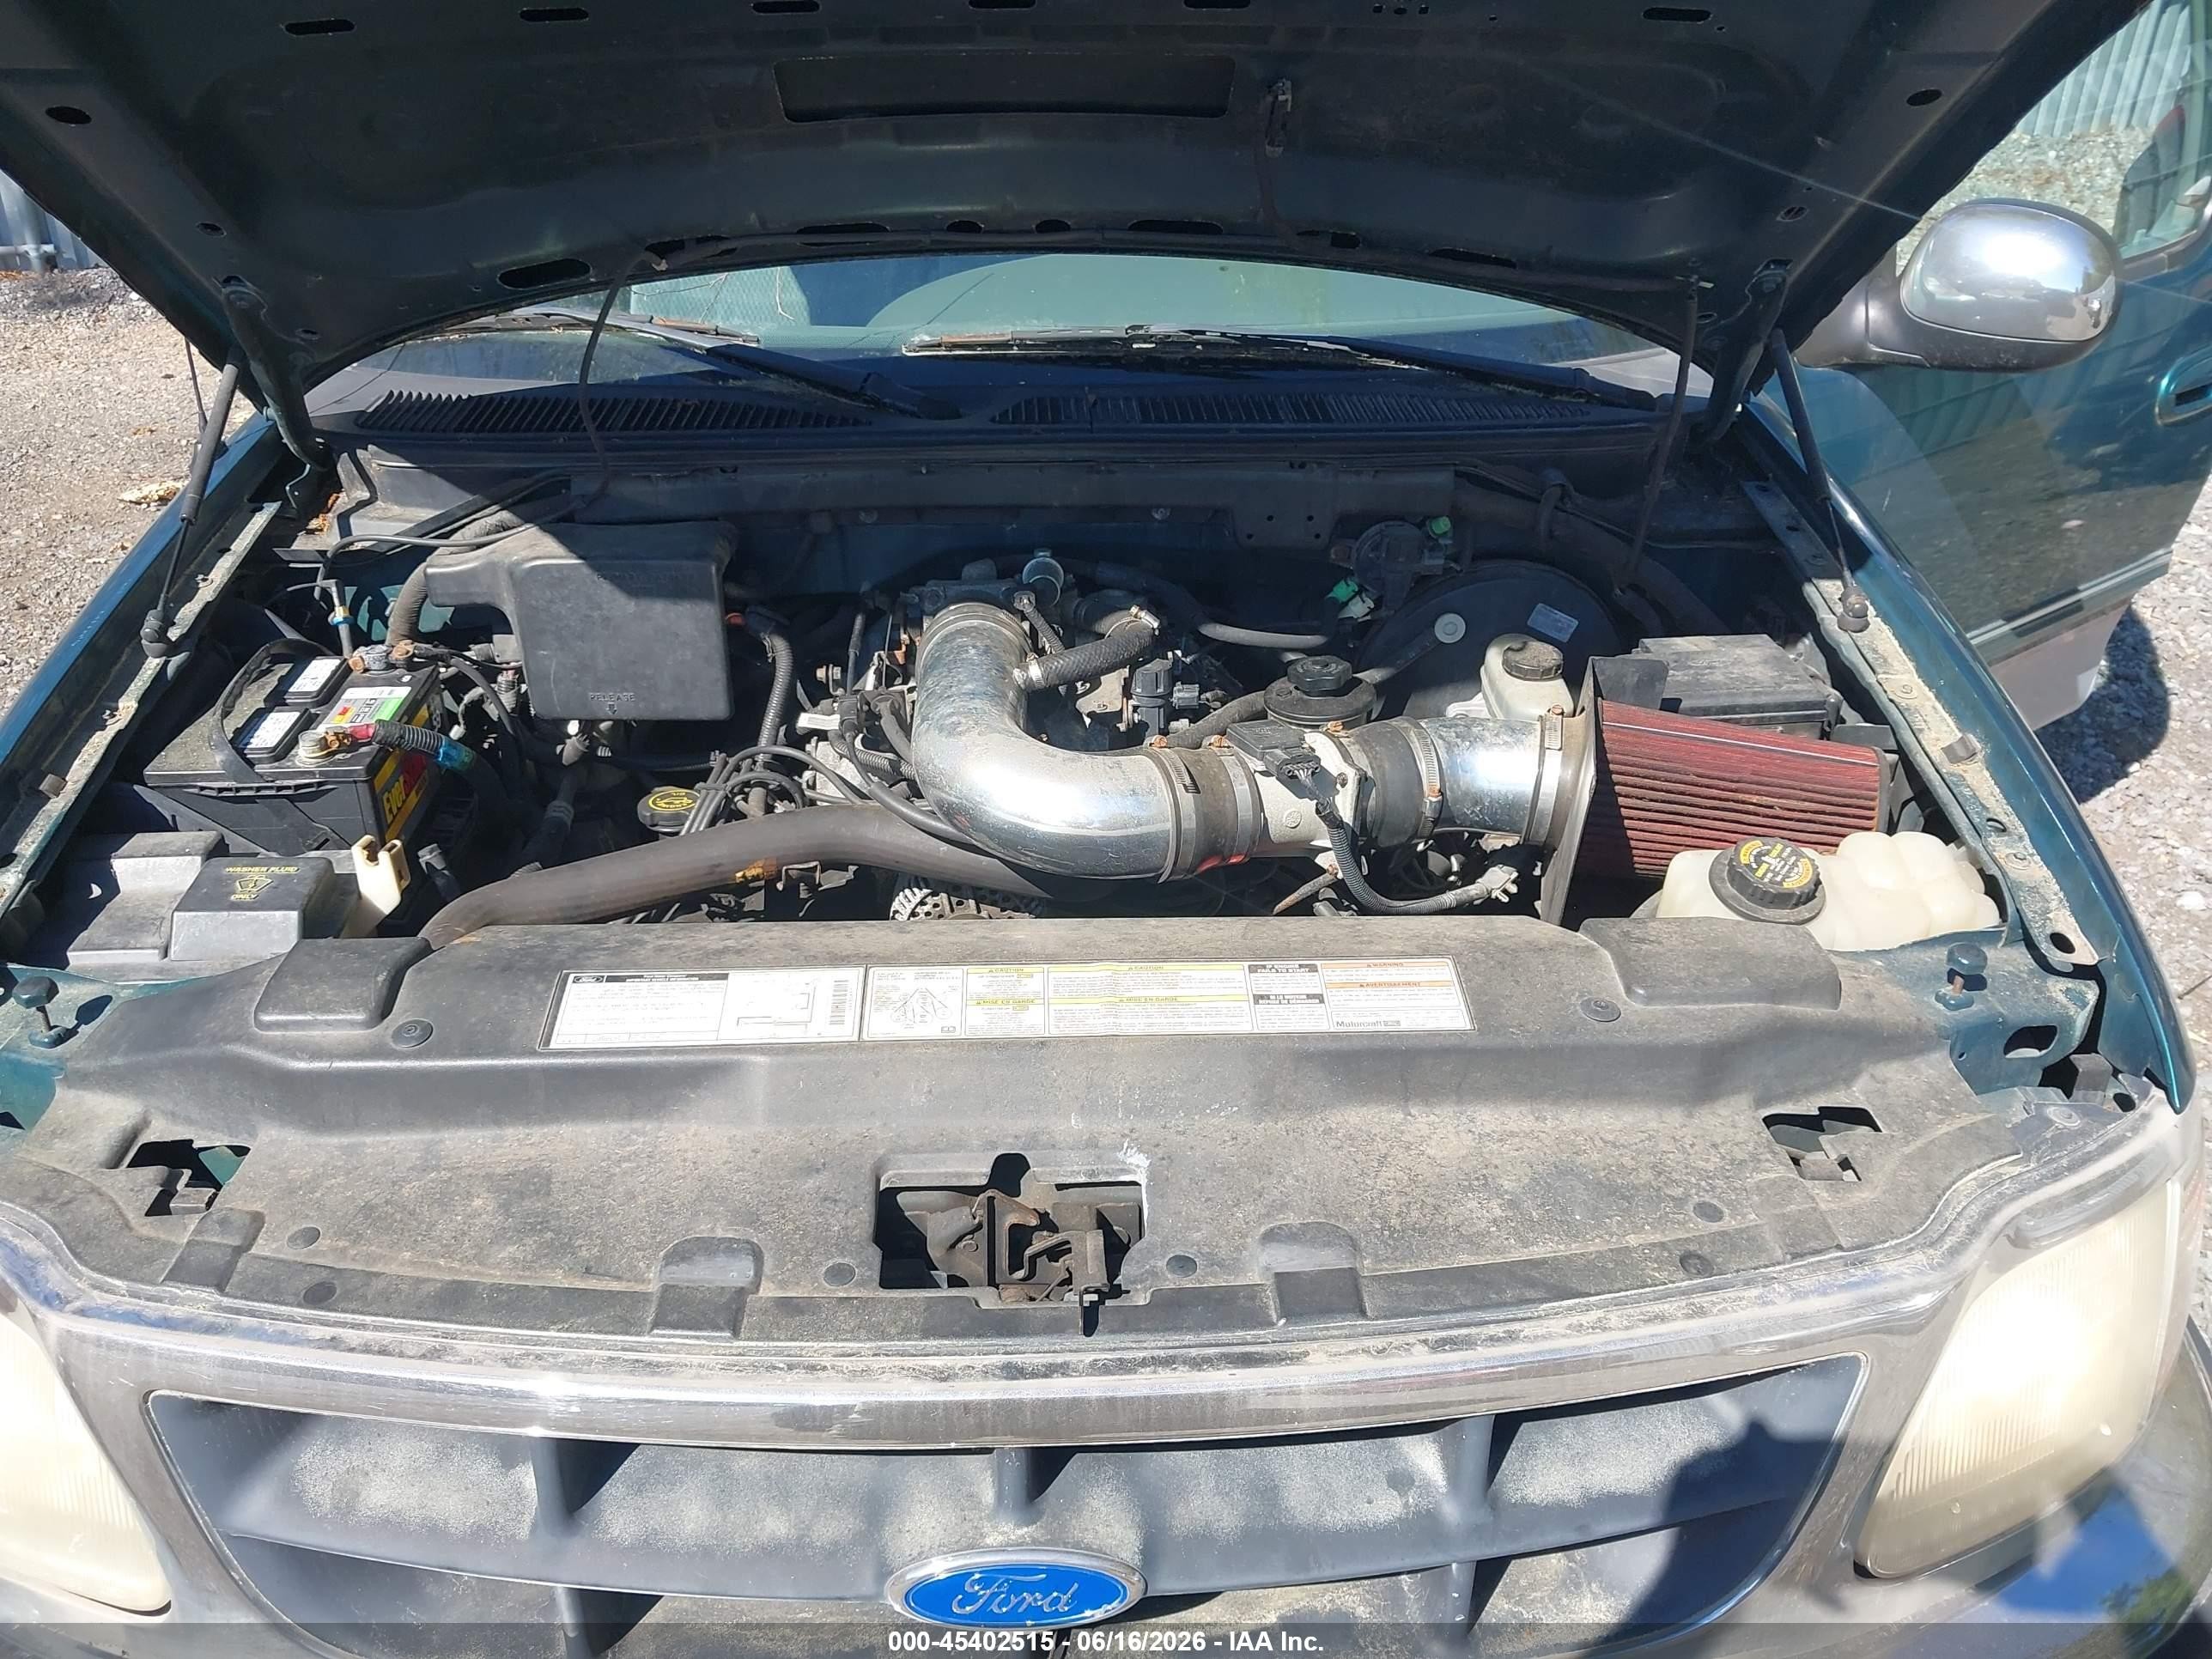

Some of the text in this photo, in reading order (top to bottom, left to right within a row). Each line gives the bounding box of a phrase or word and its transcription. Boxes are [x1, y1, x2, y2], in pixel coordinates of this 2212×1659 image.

[589, 692, 636, 702] RELEASE
[1335, 1019, 1383, 1029] Motorcraft
[951, 1572, 1079, 1614] Ford
